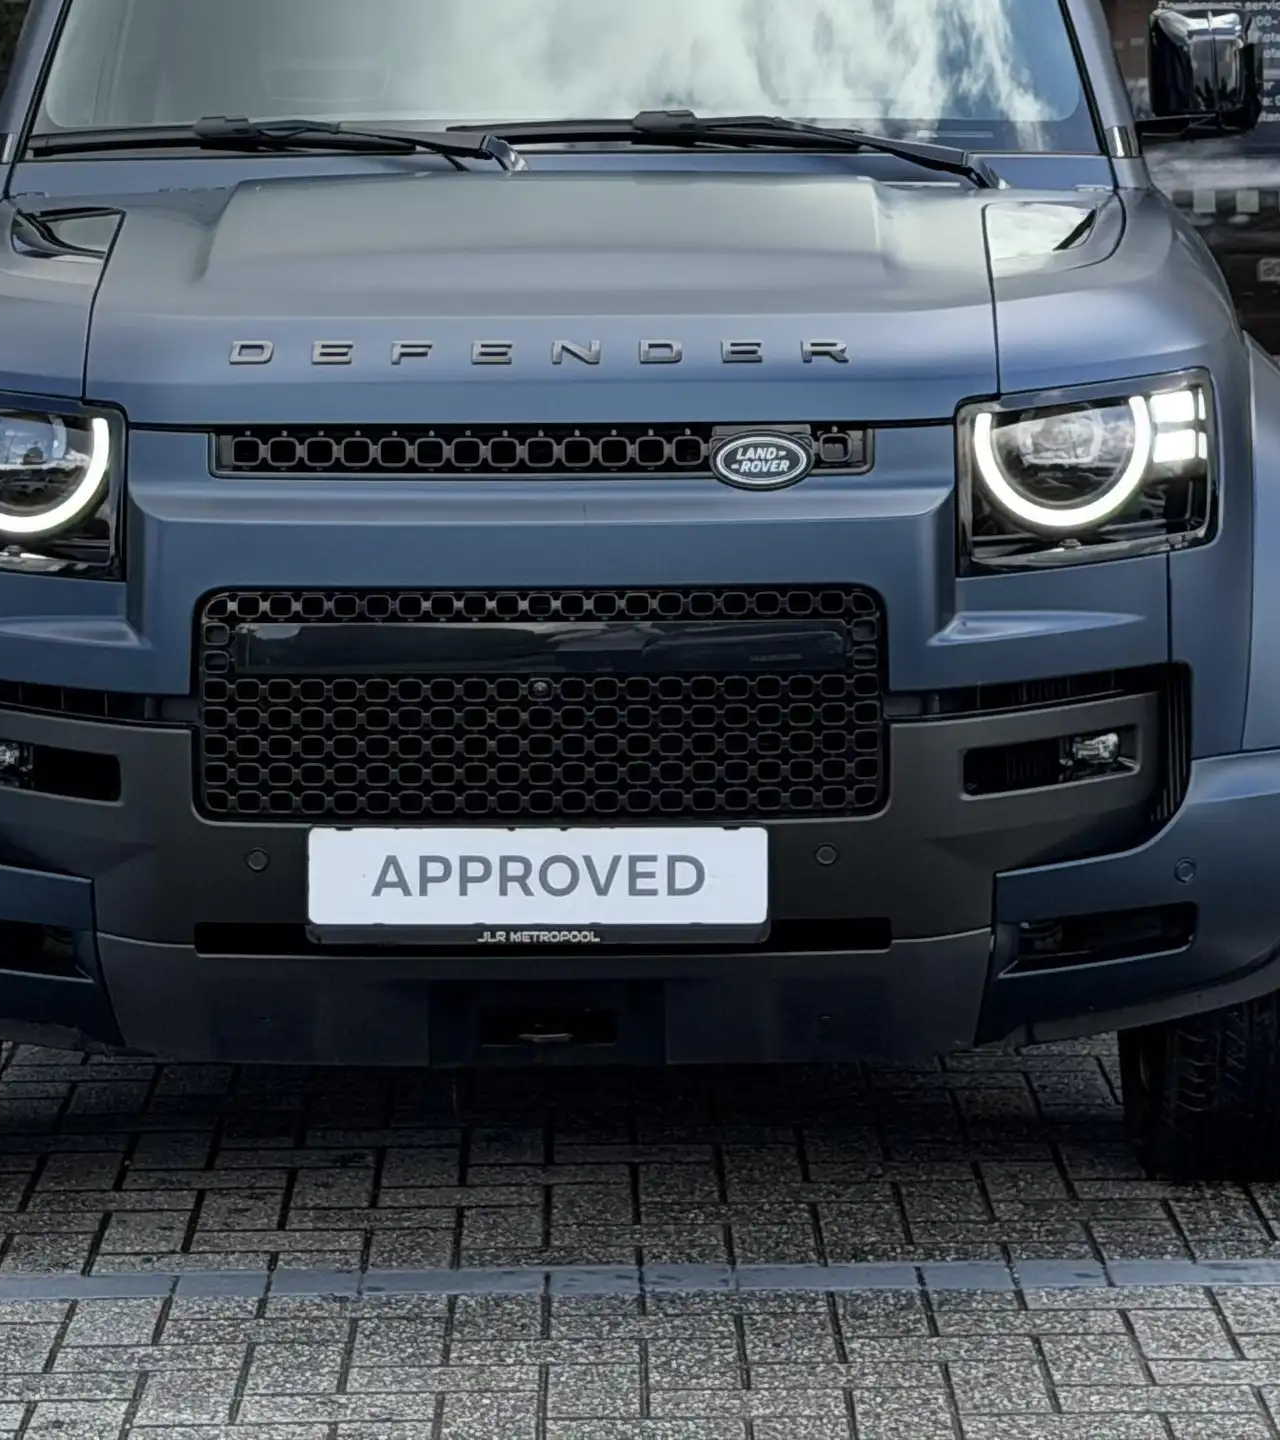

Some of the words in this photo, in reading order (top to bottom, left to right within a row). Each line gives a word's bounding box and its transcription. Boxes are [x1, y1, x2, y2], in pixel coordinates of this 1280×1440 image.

[229, 339, 849, 365] DEFENDER
[735, 447, 778, 460] LAND
[739, 460, 790, 473] ROVER
[371, 854, 706, 897] APPROVED
[477, 931, 507, 943] JLR
[509, 931, 601, 943] METROPOOL
